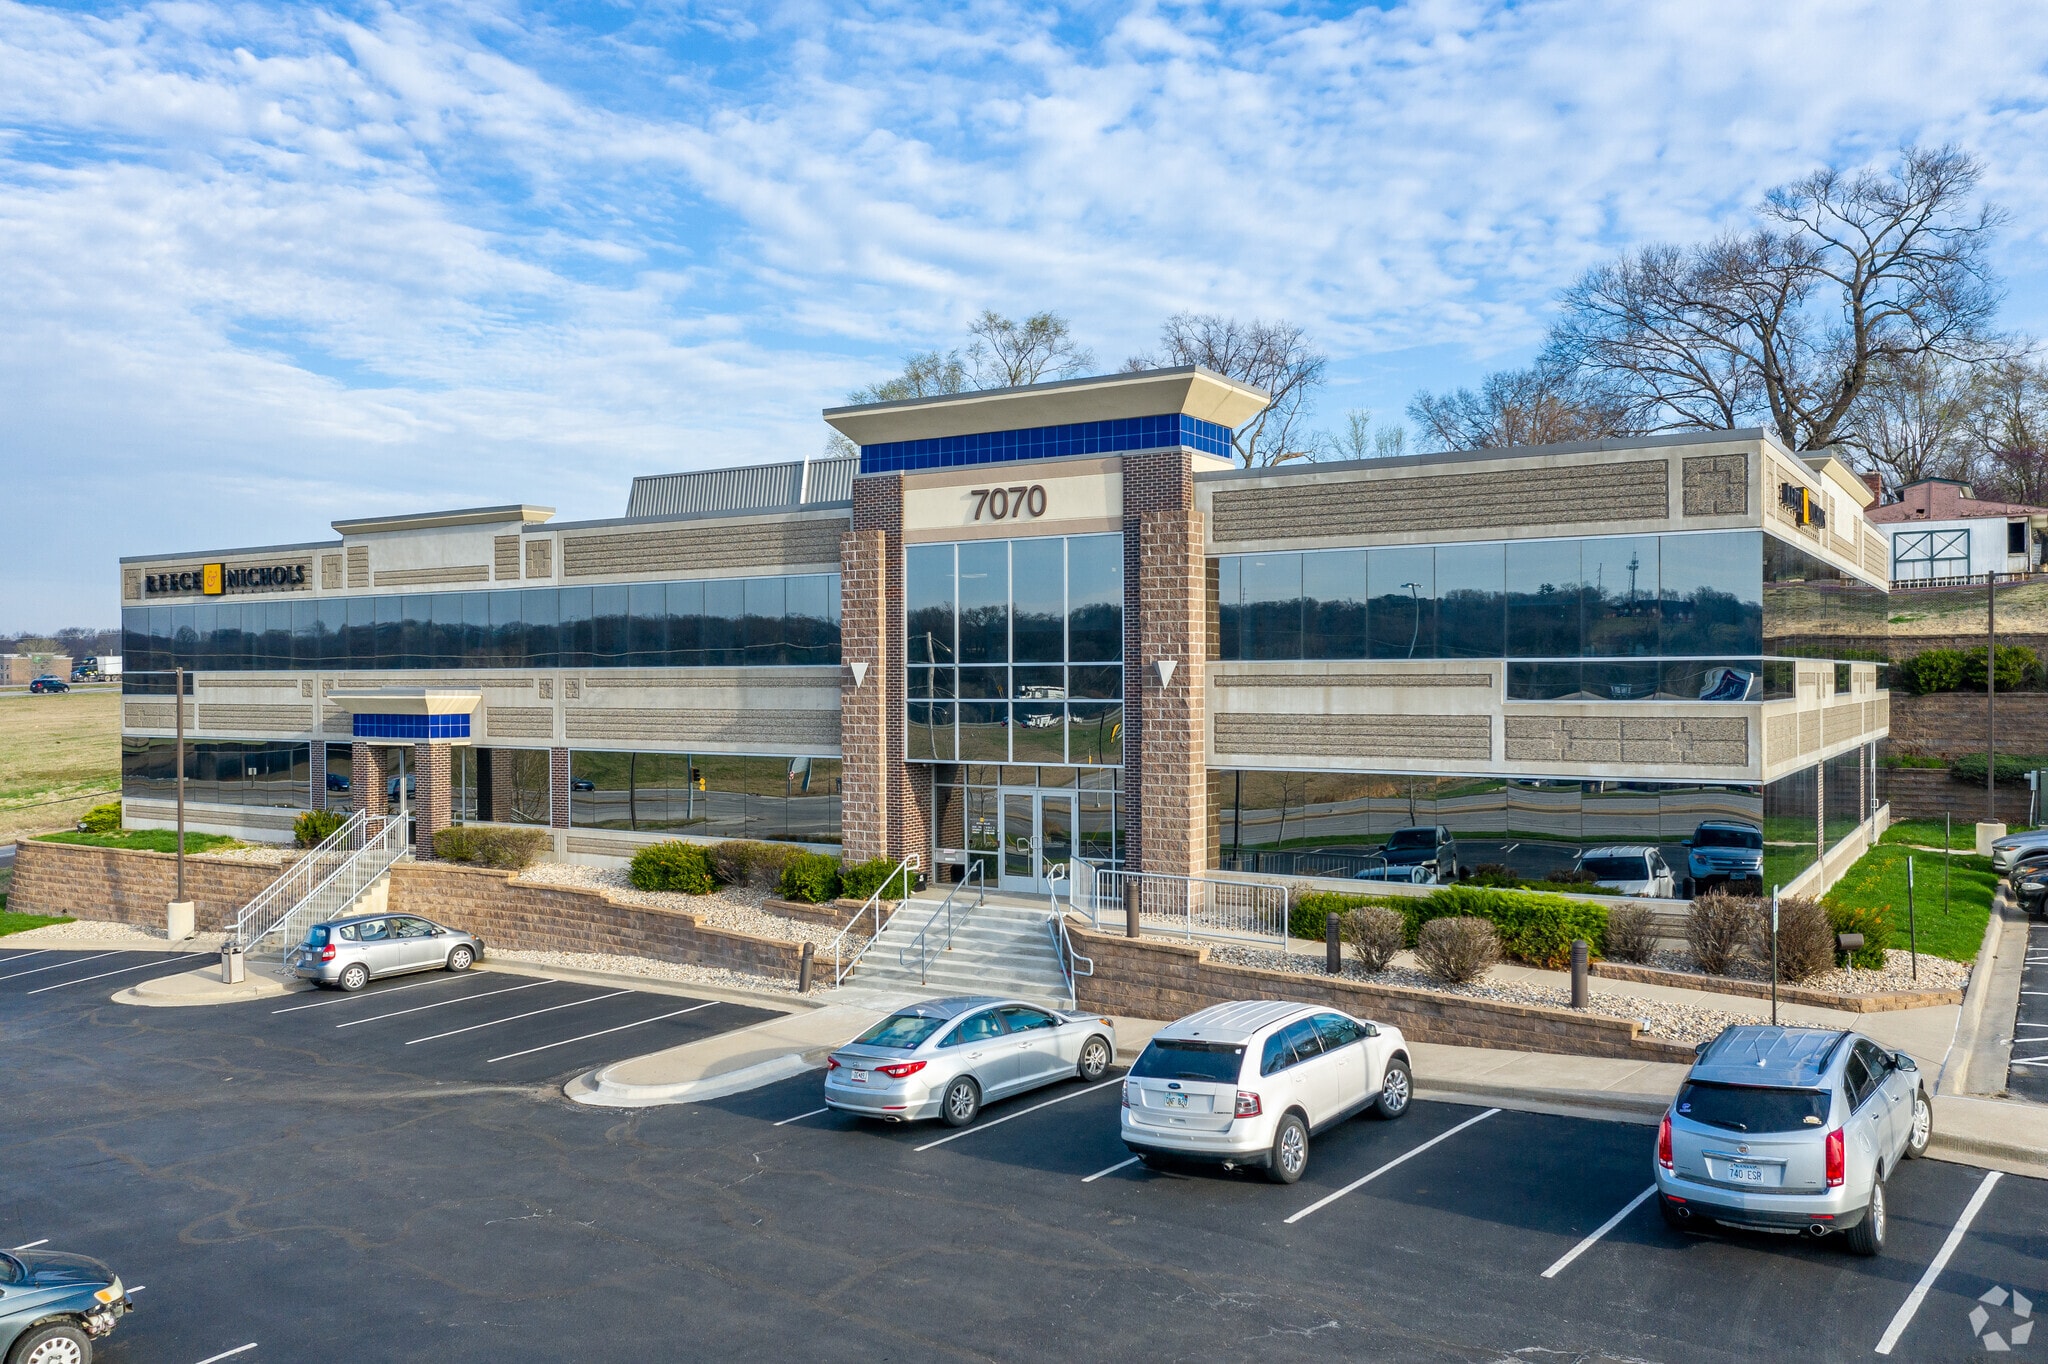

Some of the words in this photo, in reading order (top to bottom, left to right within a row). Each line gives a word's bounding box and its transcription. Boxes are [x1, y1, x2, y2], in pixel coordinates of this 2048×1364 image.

[971, 485, 1047, 520] 7070
[145, 571, 203, 593] REECE
[227, 565, 305, 589] NICHOLS
[1730, 1169, 1744, 1179] 740
[1747, 1170, 1762, 1181] ESR
